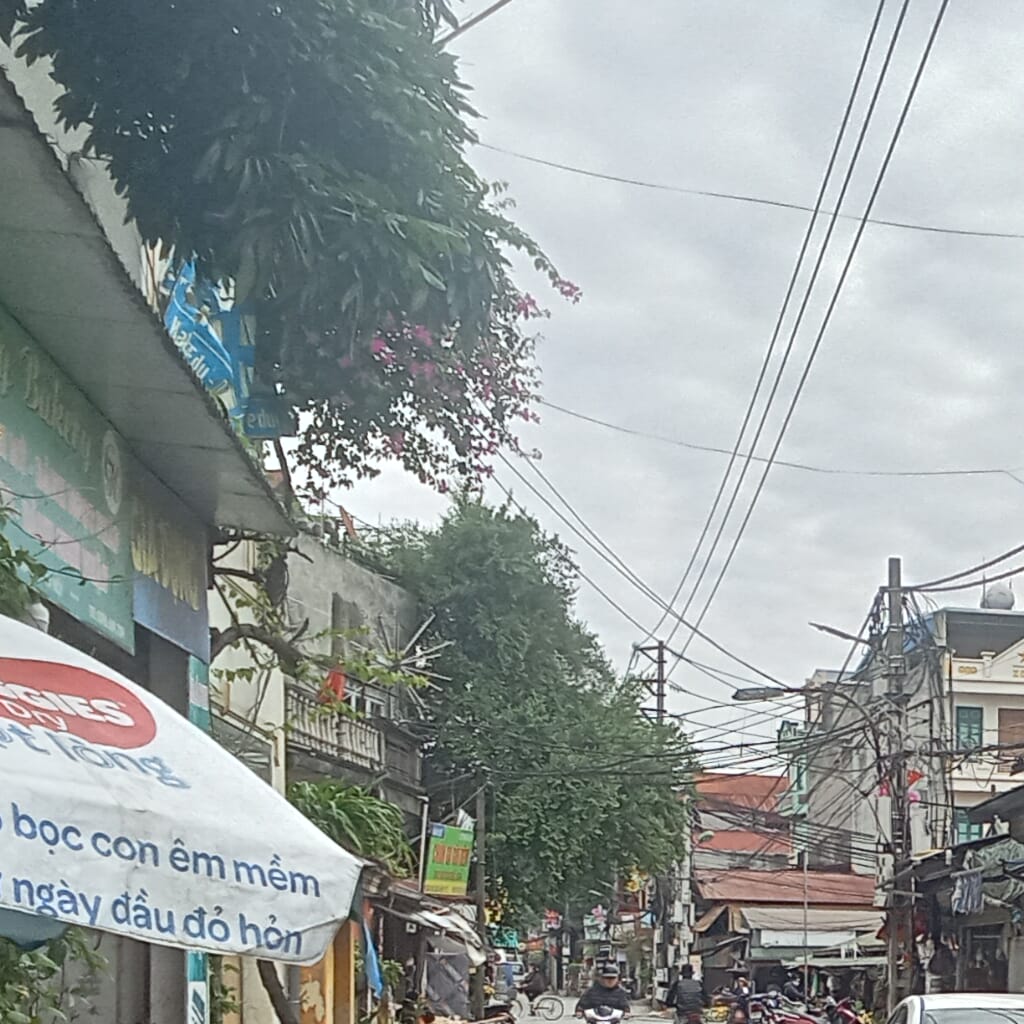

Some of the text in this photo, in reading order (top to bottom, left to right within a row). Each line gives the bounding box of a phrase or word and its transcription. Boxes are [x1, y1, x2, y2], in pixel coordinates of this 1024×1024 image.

[11, 801, 321, 899] bọc con êm mềm
[13, 877, 303, 956] ngày đầu đỏ hỏn
